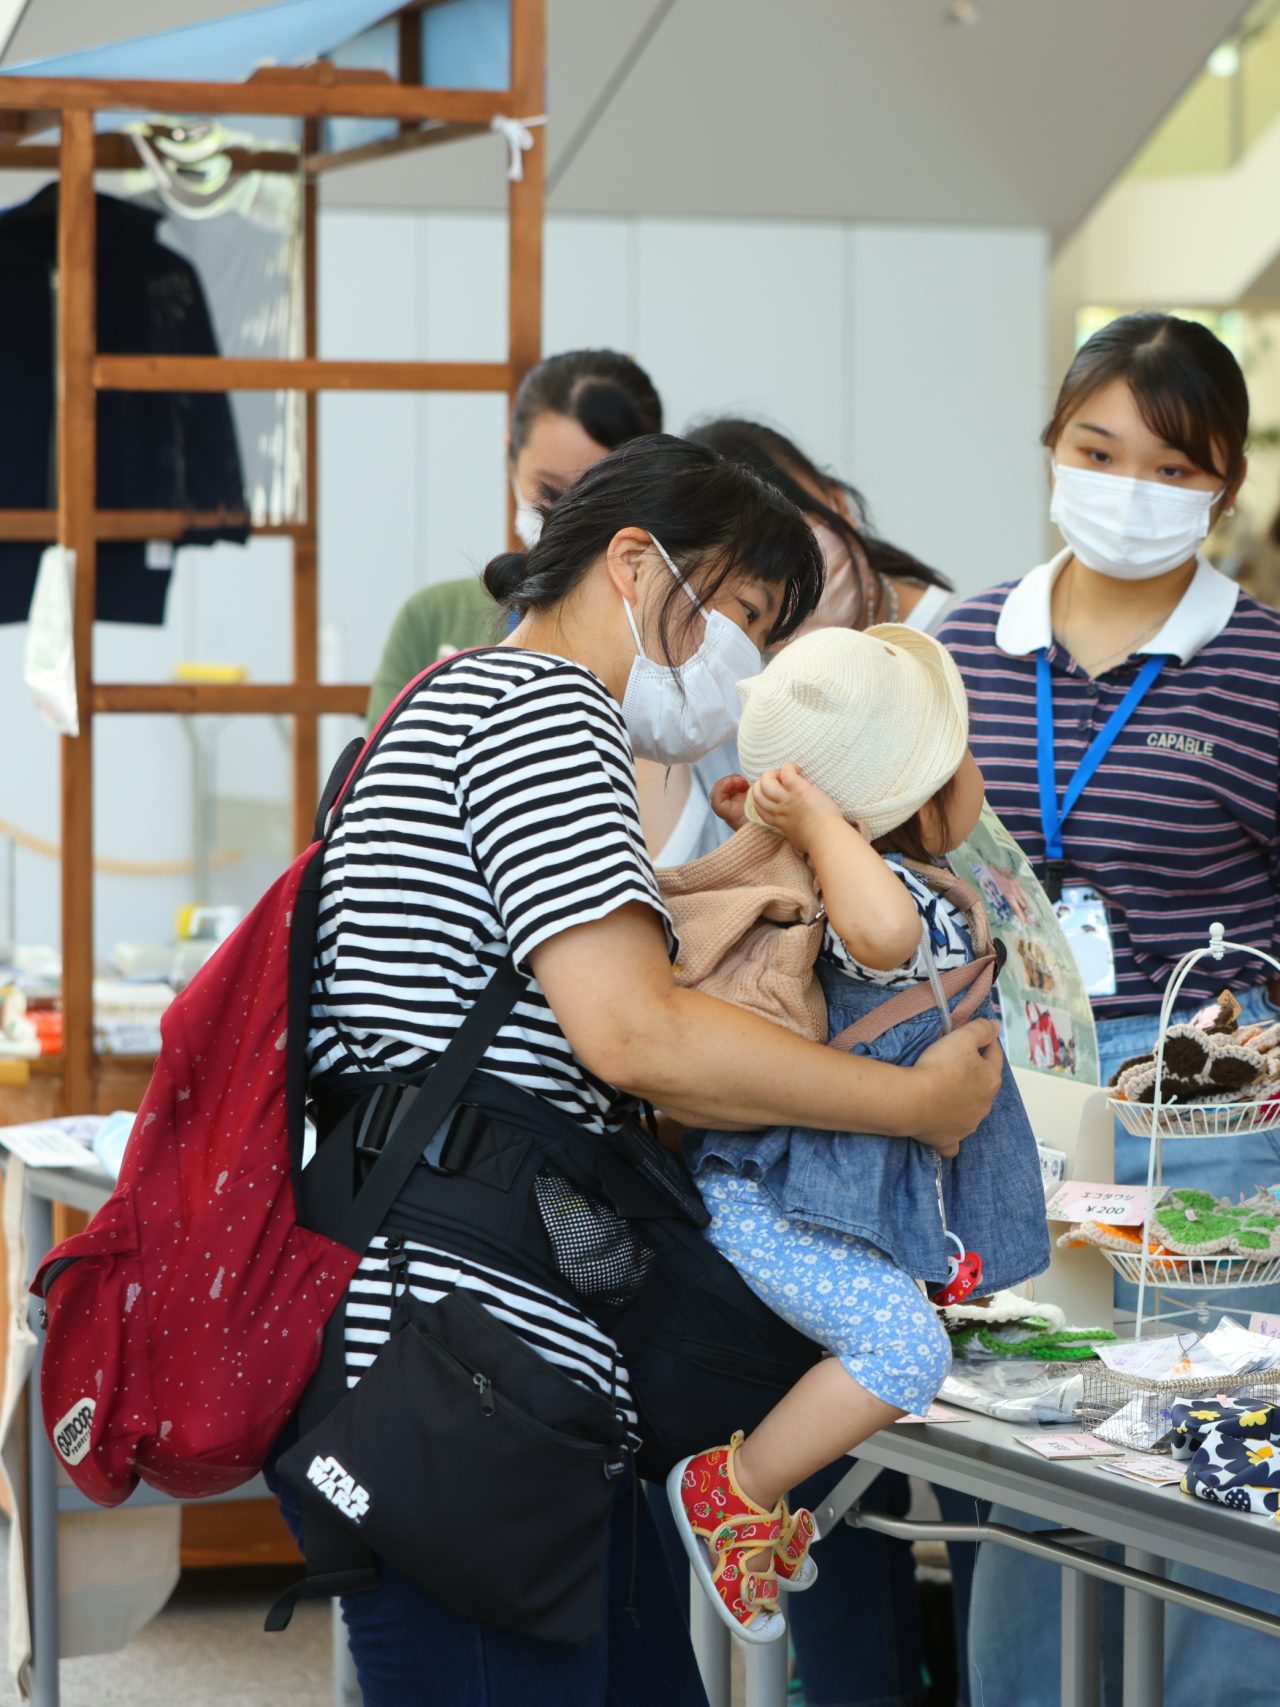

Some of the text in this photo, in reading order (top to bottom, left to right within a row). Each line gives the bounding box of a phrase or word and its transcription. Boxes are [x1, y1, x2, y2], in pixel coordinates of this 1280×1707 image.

[1146, 732, 1215, 757] CAPABLE
[1081, 1191, 1135, 1201] エコタワシ
[306, 1461, 366, 1519] WARS
[313, 1455, 370, 1513] STAR
